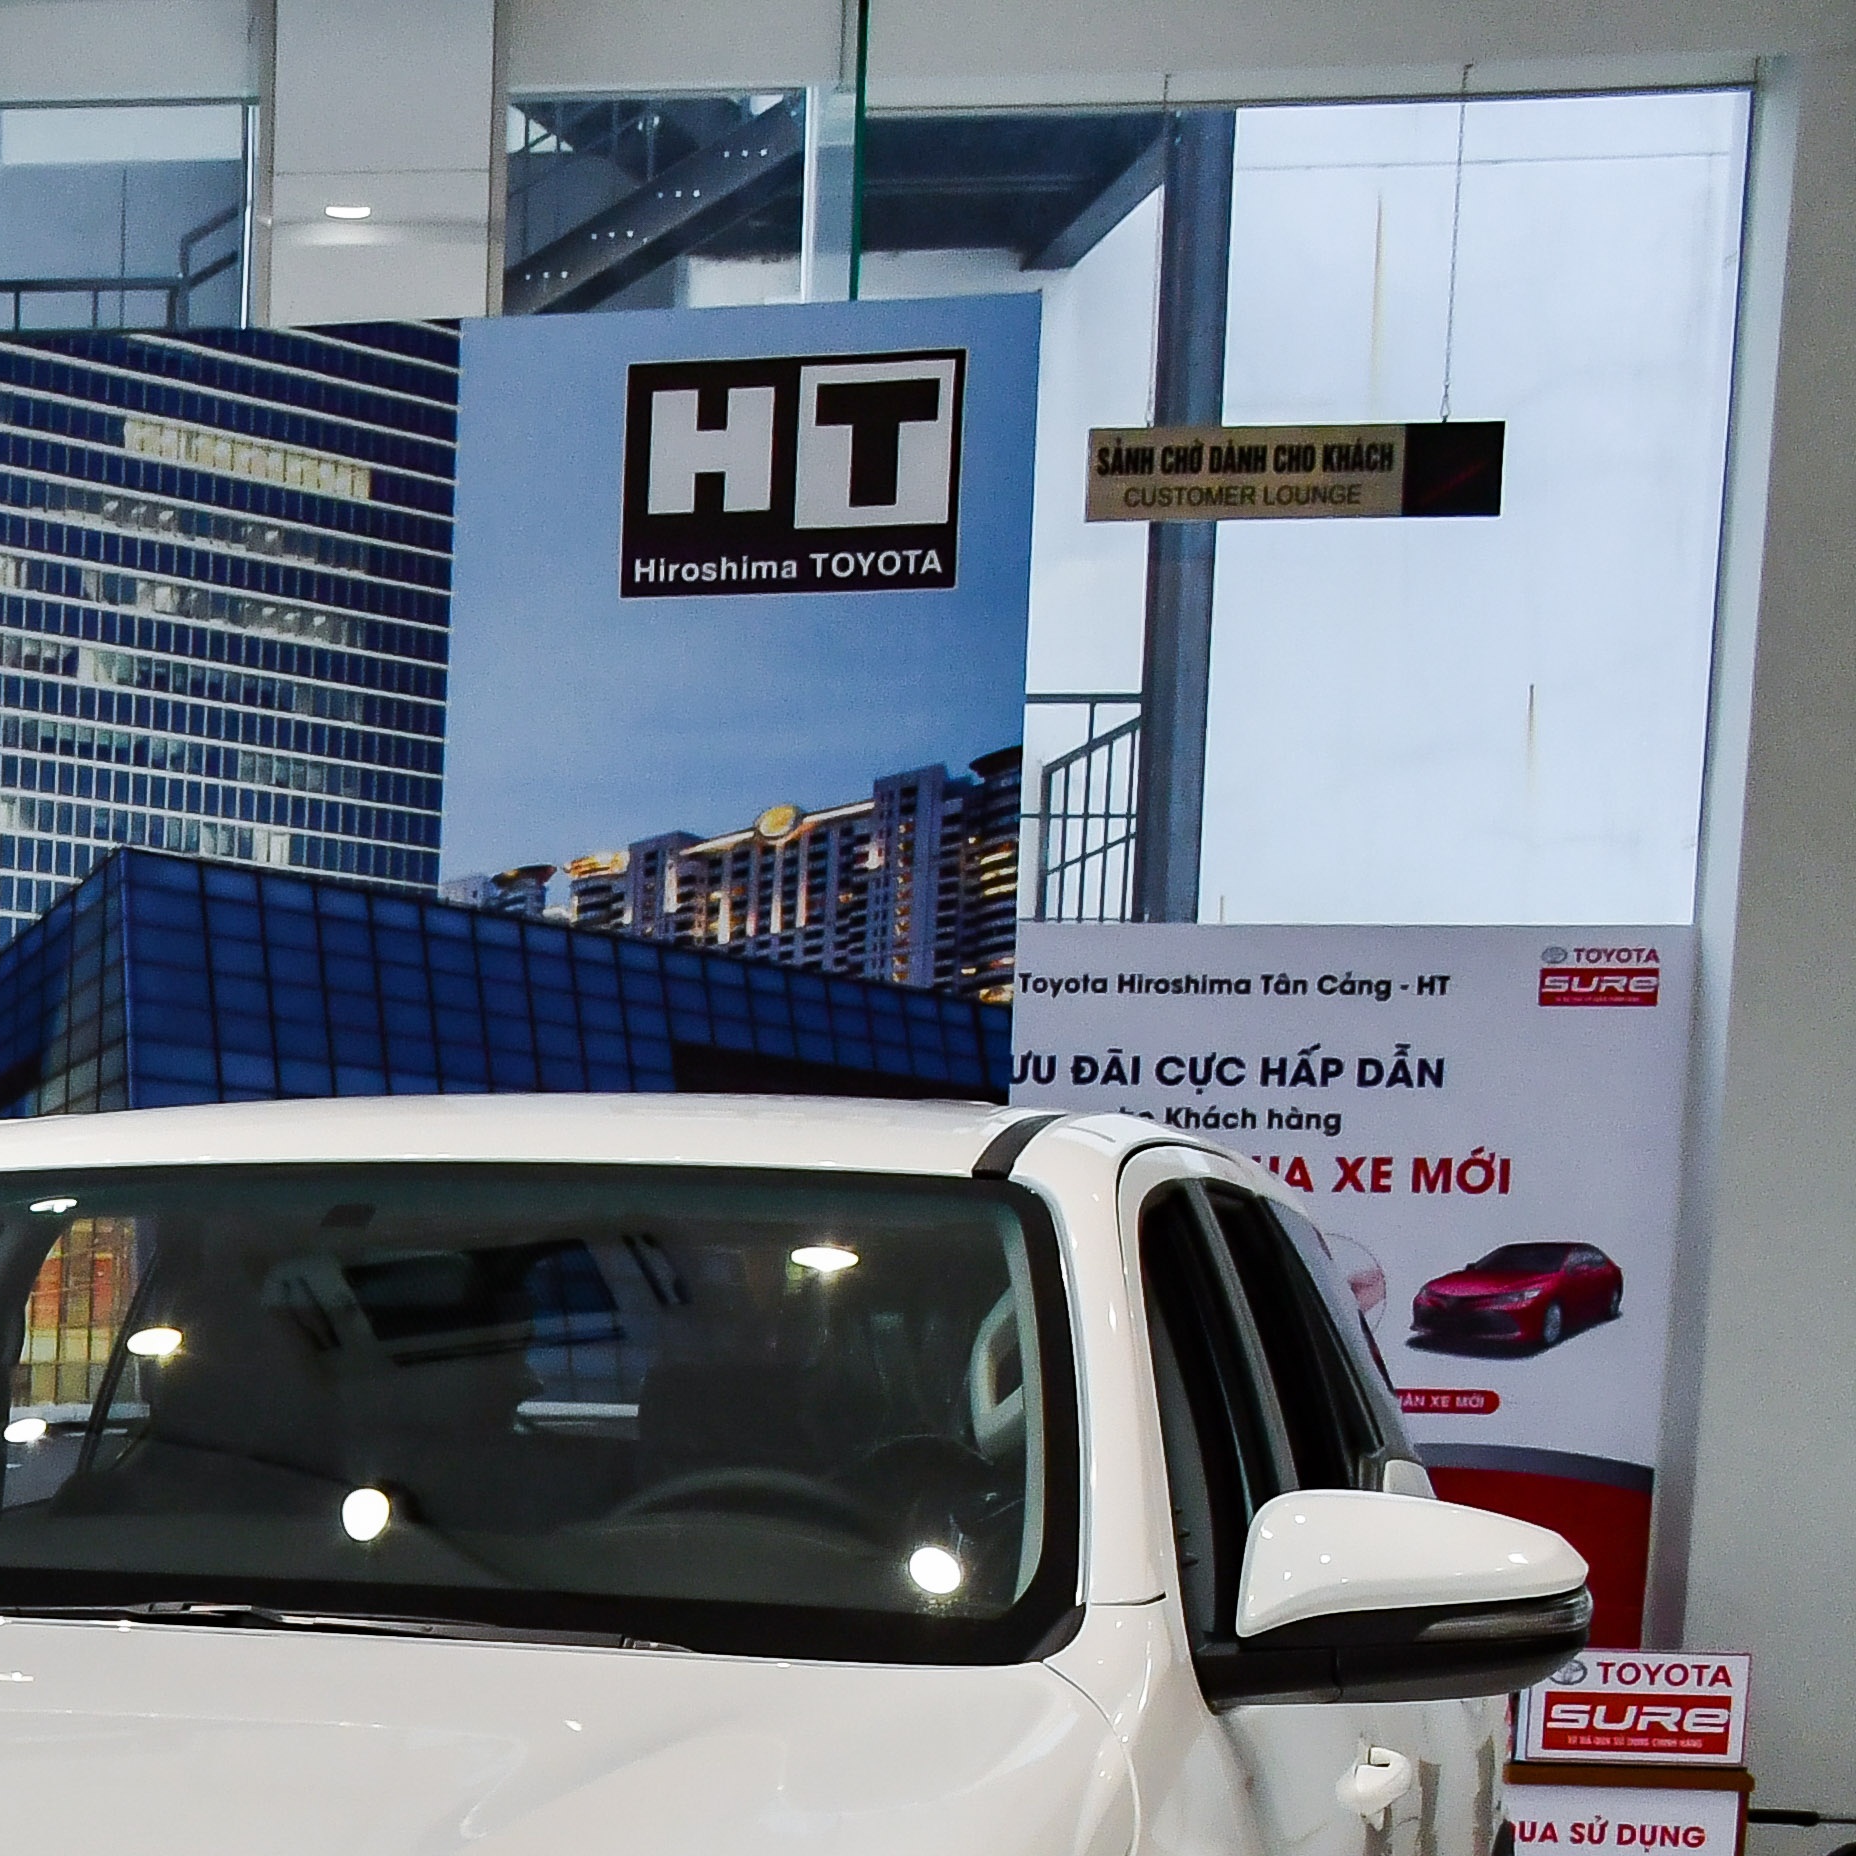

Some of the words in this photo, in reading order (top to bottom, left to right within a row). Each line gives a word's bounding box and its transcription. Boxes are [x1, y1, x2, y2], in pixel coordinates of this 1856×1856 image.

[648, 378, 940, 514] HT
[1273, 443, 1316, 474] CHO
[1322, 438, 1394, 472] KHÁCH
[1123, 485, 1256, 507] CUSTOMER
[1263, 484, 1362, 505] LOUNGE
[634, 555, 797, 584] Hiroshima
[809, 549, 943, 579] TOYOTA
[1574, 947, 1660, 963] TOYOTA
[1019, 973, 1107, 999] Toyota
[1118, 973, 1251, 996] Hiroshima
[1261, 973, 1308, 995] Tân
[1317, 971, 1391, 1001] Cảng
[1417, 976, 1451, 995] HT
[1071, 1048, 1141, 1086] ĐÃI
[1155, 1052, 1246, 1095] CỰC
[1260, 1043, 1344, 1088] HẤP
[1356, 1043, 1445, 1088] DẪN
[1165, 1104, 1257, 1130] Khách
[1267, 1106, 1341, 1137] hàng
[1332, 1156, 1393, 1193] XE
[1411, 1146, 1511, 1195] MỚI
[1430, 1395, 1451, 1407] XE
[1597, 1662, 1733, 1687] TOYOTA
[1511, 1821, 1558, 1843] UA
[1570, 1815, 1609, 1845] SỬ
[1616, 1824, 1706, 1853] DỤNG
